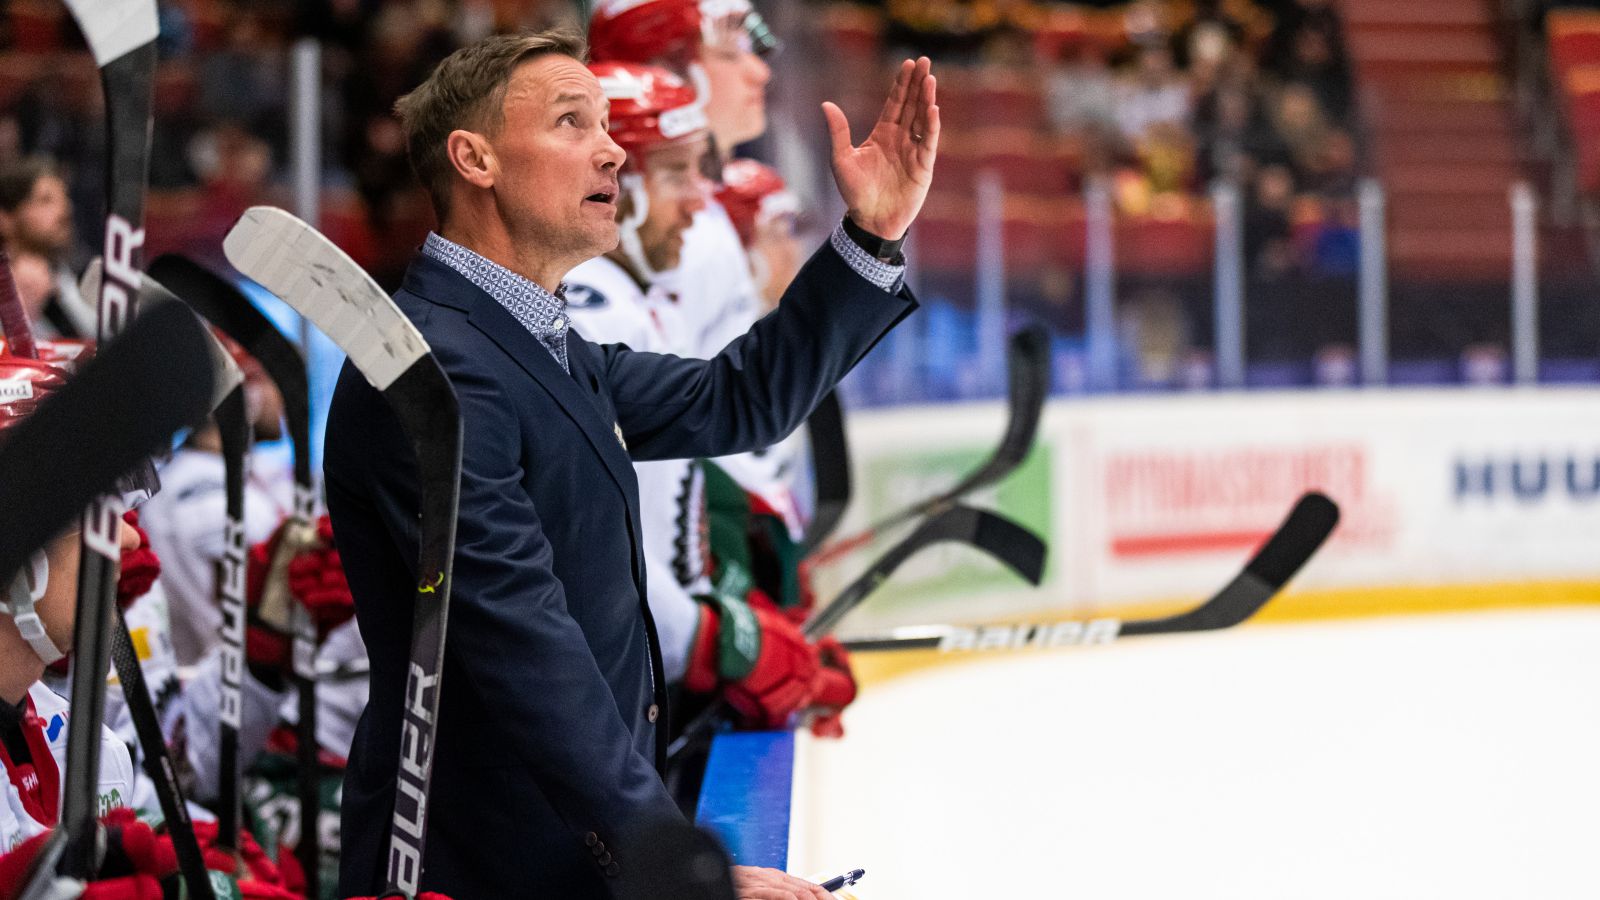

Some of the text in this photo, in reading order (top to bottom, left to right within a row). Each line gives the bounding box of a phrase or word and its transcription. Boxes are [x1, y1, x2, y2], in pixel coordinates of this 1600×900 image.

[219, 515, 246, 728] BAUER
[938, 619, 1120, 652] BAUER
[387, 661, 438, 897] AUER
